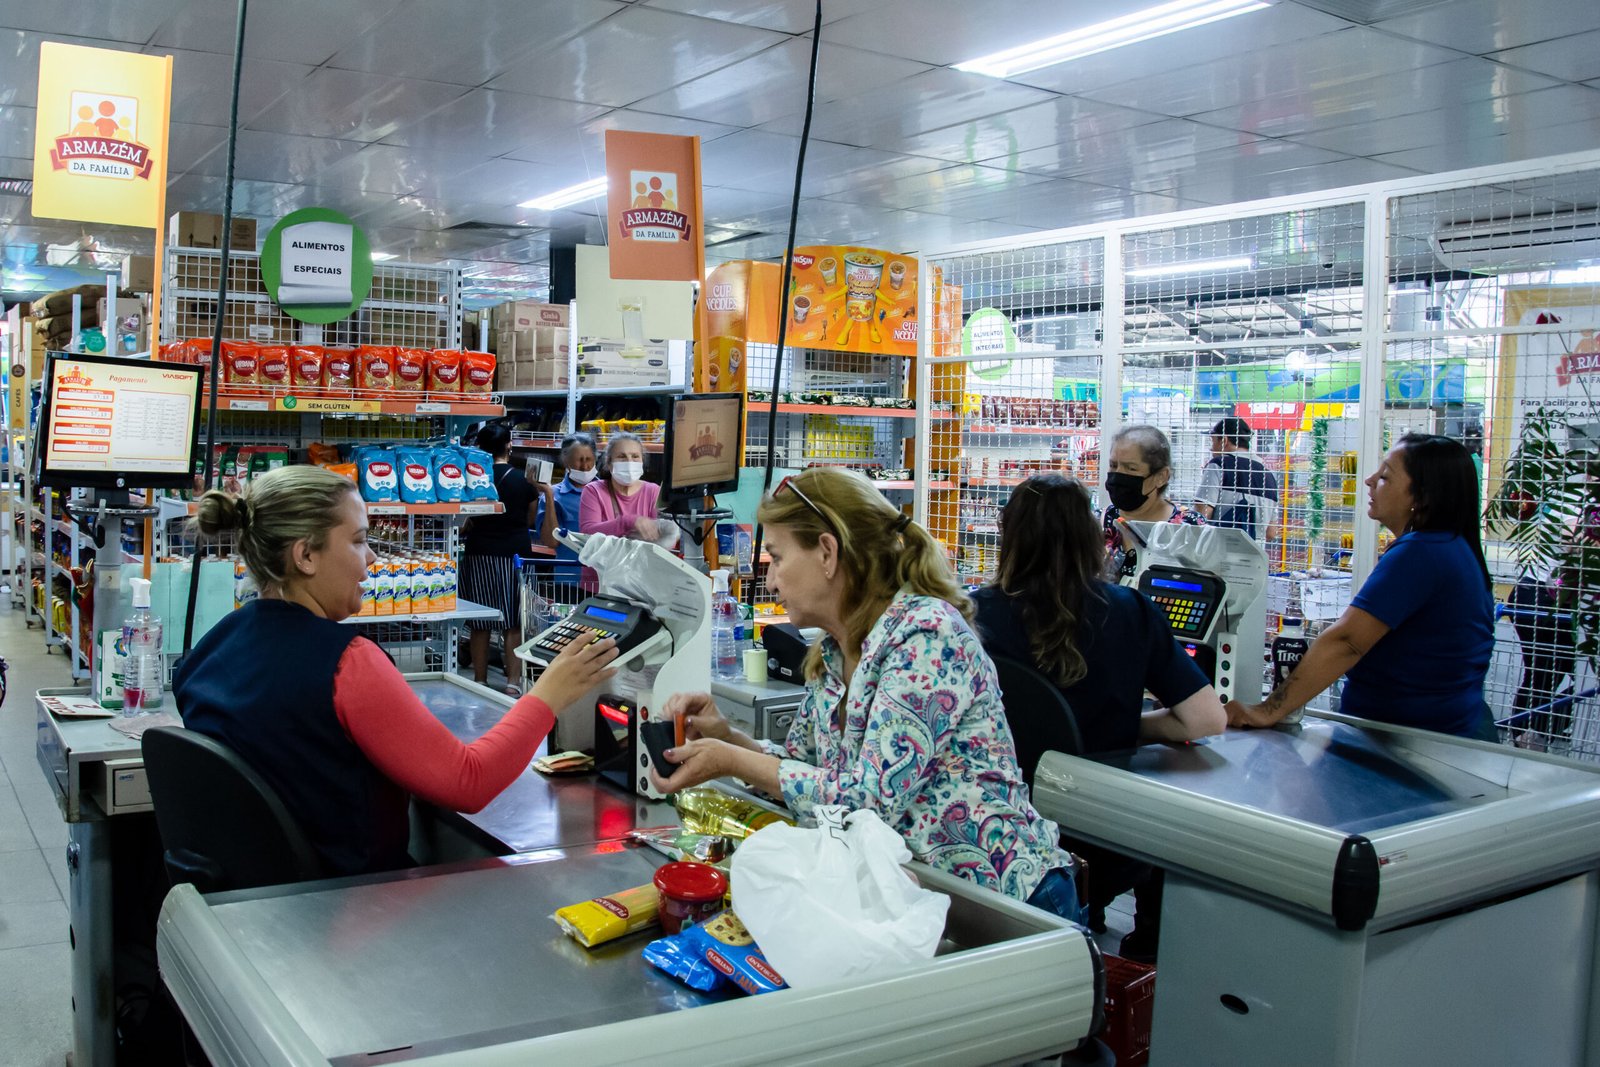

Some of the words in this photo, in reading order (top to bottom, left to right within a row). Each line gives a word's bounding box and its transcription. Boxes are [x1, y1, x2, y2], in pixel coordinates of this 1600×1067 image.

[62, 140, 142, 163] ARMAZÉM
[73, 162, 86, 171] DA
[90, 164, 129, 175] FAMÍLIA
[627, 211, 683, 228] ARMAZÉM
[635, 230, 646, 238] DA
[647, 231, 676, 239] FAMÍLIA
[291, 241, 346, 252] ALIMENTOS
[793, 255, 813, 265] NISSIN
[293, 265, 342, 275] ESPECIAIS
[713, 284, 732, 298] CUP
[235, 360, 255, 369] URBANO
[266, 364, 285, 372] URBANO
[109, 374, 148, 384] Pagamento
[162, 373, 193, 381] VIASOFT
